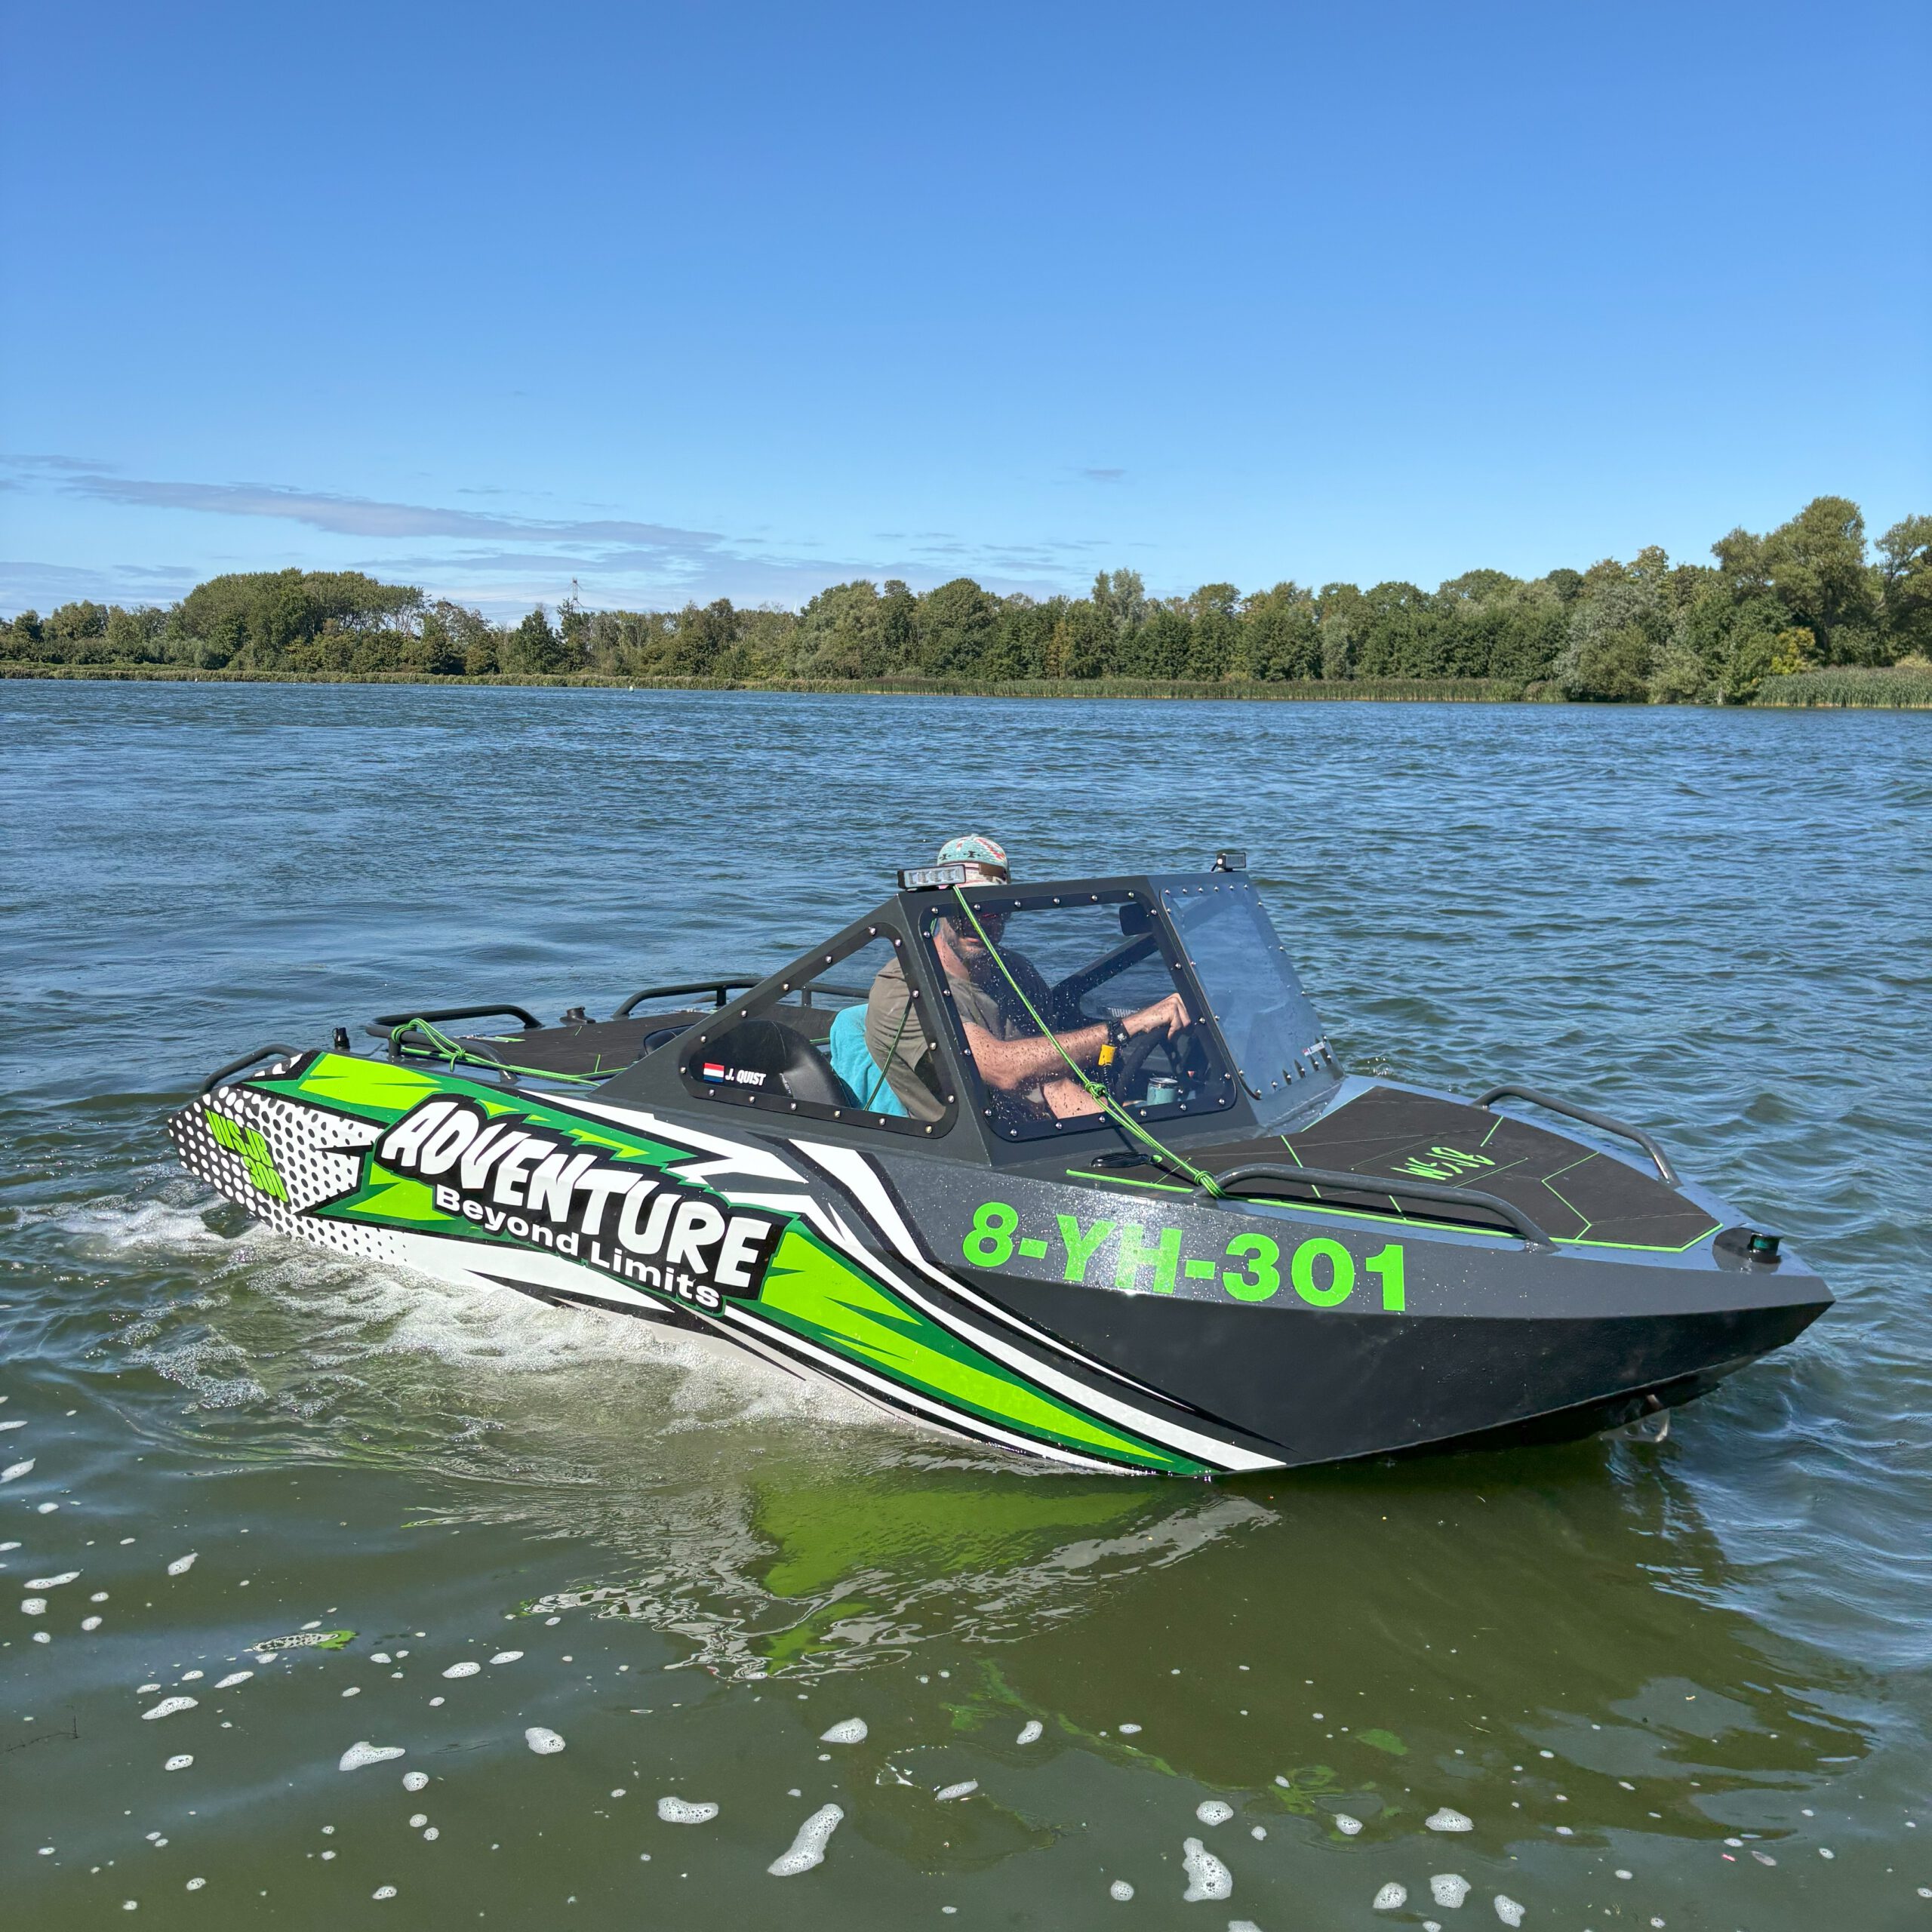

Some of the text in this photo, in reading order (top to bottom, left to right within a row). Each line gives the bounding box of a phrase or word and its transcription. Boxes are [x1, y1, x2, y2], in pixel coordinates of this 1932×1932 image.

[724, 1068, 766, 1086] J. QUIST
[243, 1155, 288, 1202] 300
[380, 1101, 772, 1287] ADVENTURE
[435, 1184, 720, 1309] Beyond Limits
[962, 1201, 1406, 1312] 8-YH-301
